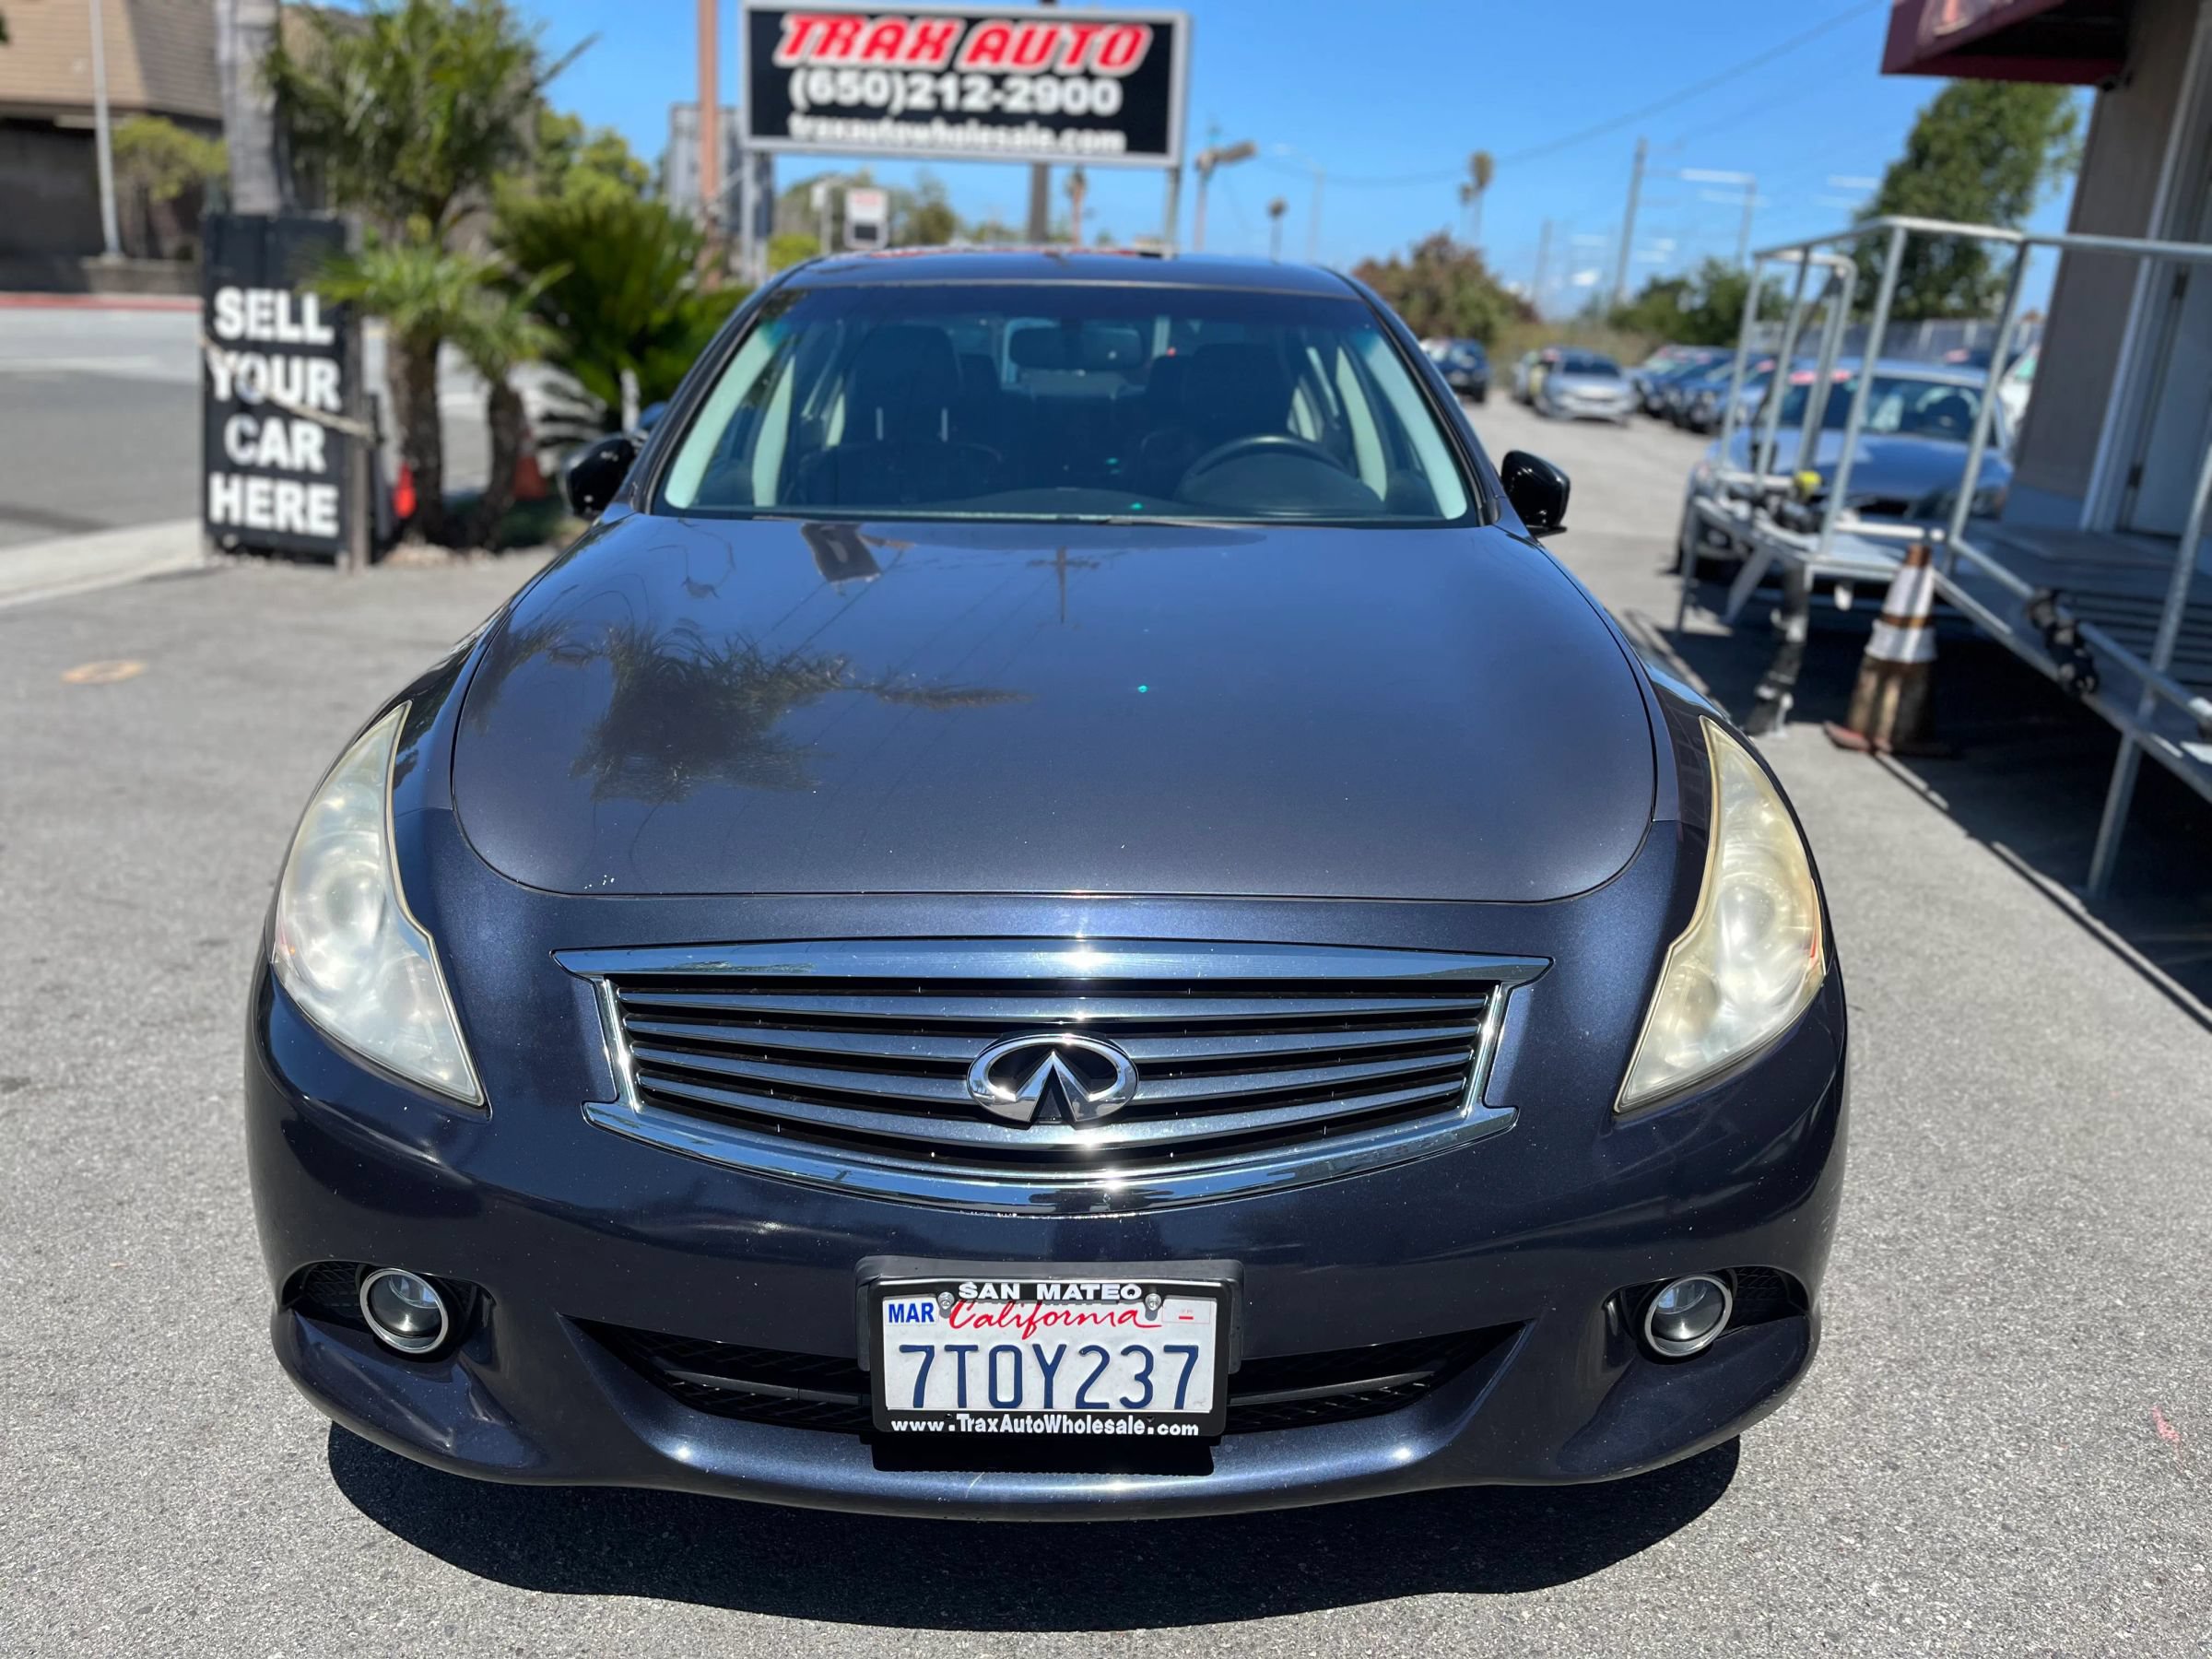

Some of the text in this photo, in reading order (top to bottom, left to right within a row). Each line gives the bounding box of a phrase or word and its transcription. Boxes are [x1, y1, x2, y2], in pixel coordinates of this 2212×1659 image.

[774, 14, 1152, 75] TRAX AUTO
[790, 68, 1122, 114] (650)212-2900
[214, 287, 335, 345] SELL
[207, 349, 342, 411] YOUR
[224, 414, 326, 473] CAR
[208, 472, 339, 537] HERE
[888, 1302, 935, 1324] MAR
[948, 1300, 1162, 1340] California
[959, 1283, 1142, 1300] SAN MATEO
[899, 1345, 1199, 1410] 7TOY237
[891, 1413, 1199, 1436] www.TraxAutoWholesale.com
